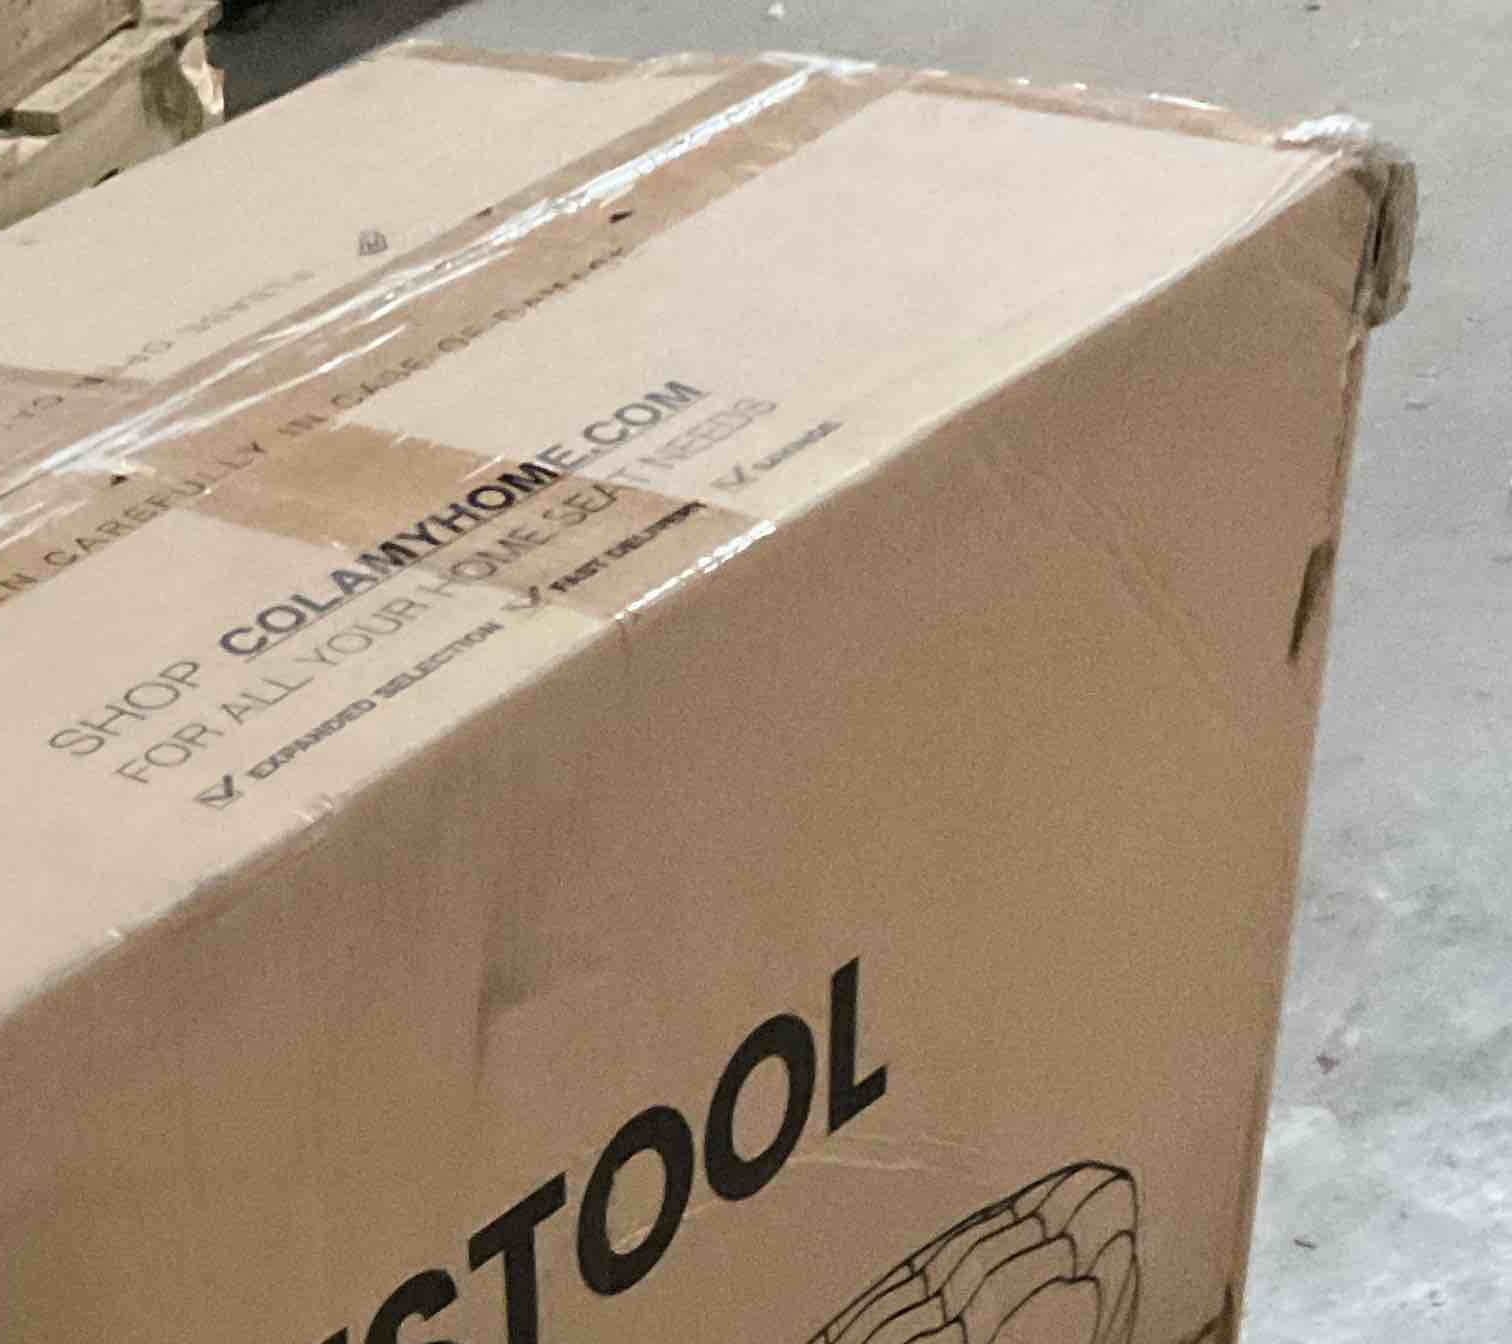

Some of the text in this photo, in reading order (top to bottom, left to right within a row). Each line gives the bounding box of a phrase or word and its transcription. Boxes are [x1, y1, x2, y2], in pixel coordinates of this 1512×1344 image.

[43, 439, 268, 570] CAREFULLY
[47, 660, 200, 756] SHOP
[218, 381, 710, 658] COLAMYHOME.COM
[114, 721, 225, 784] FOR
[220, 675, 316, 725] ALL
[294, 598, 432, 667] YOUR
[418, 523, 554, 599] HOME
[640, 396, 780, 471] NEEDS
[246, 619, 505, 780] EXPANDED SELECTION
